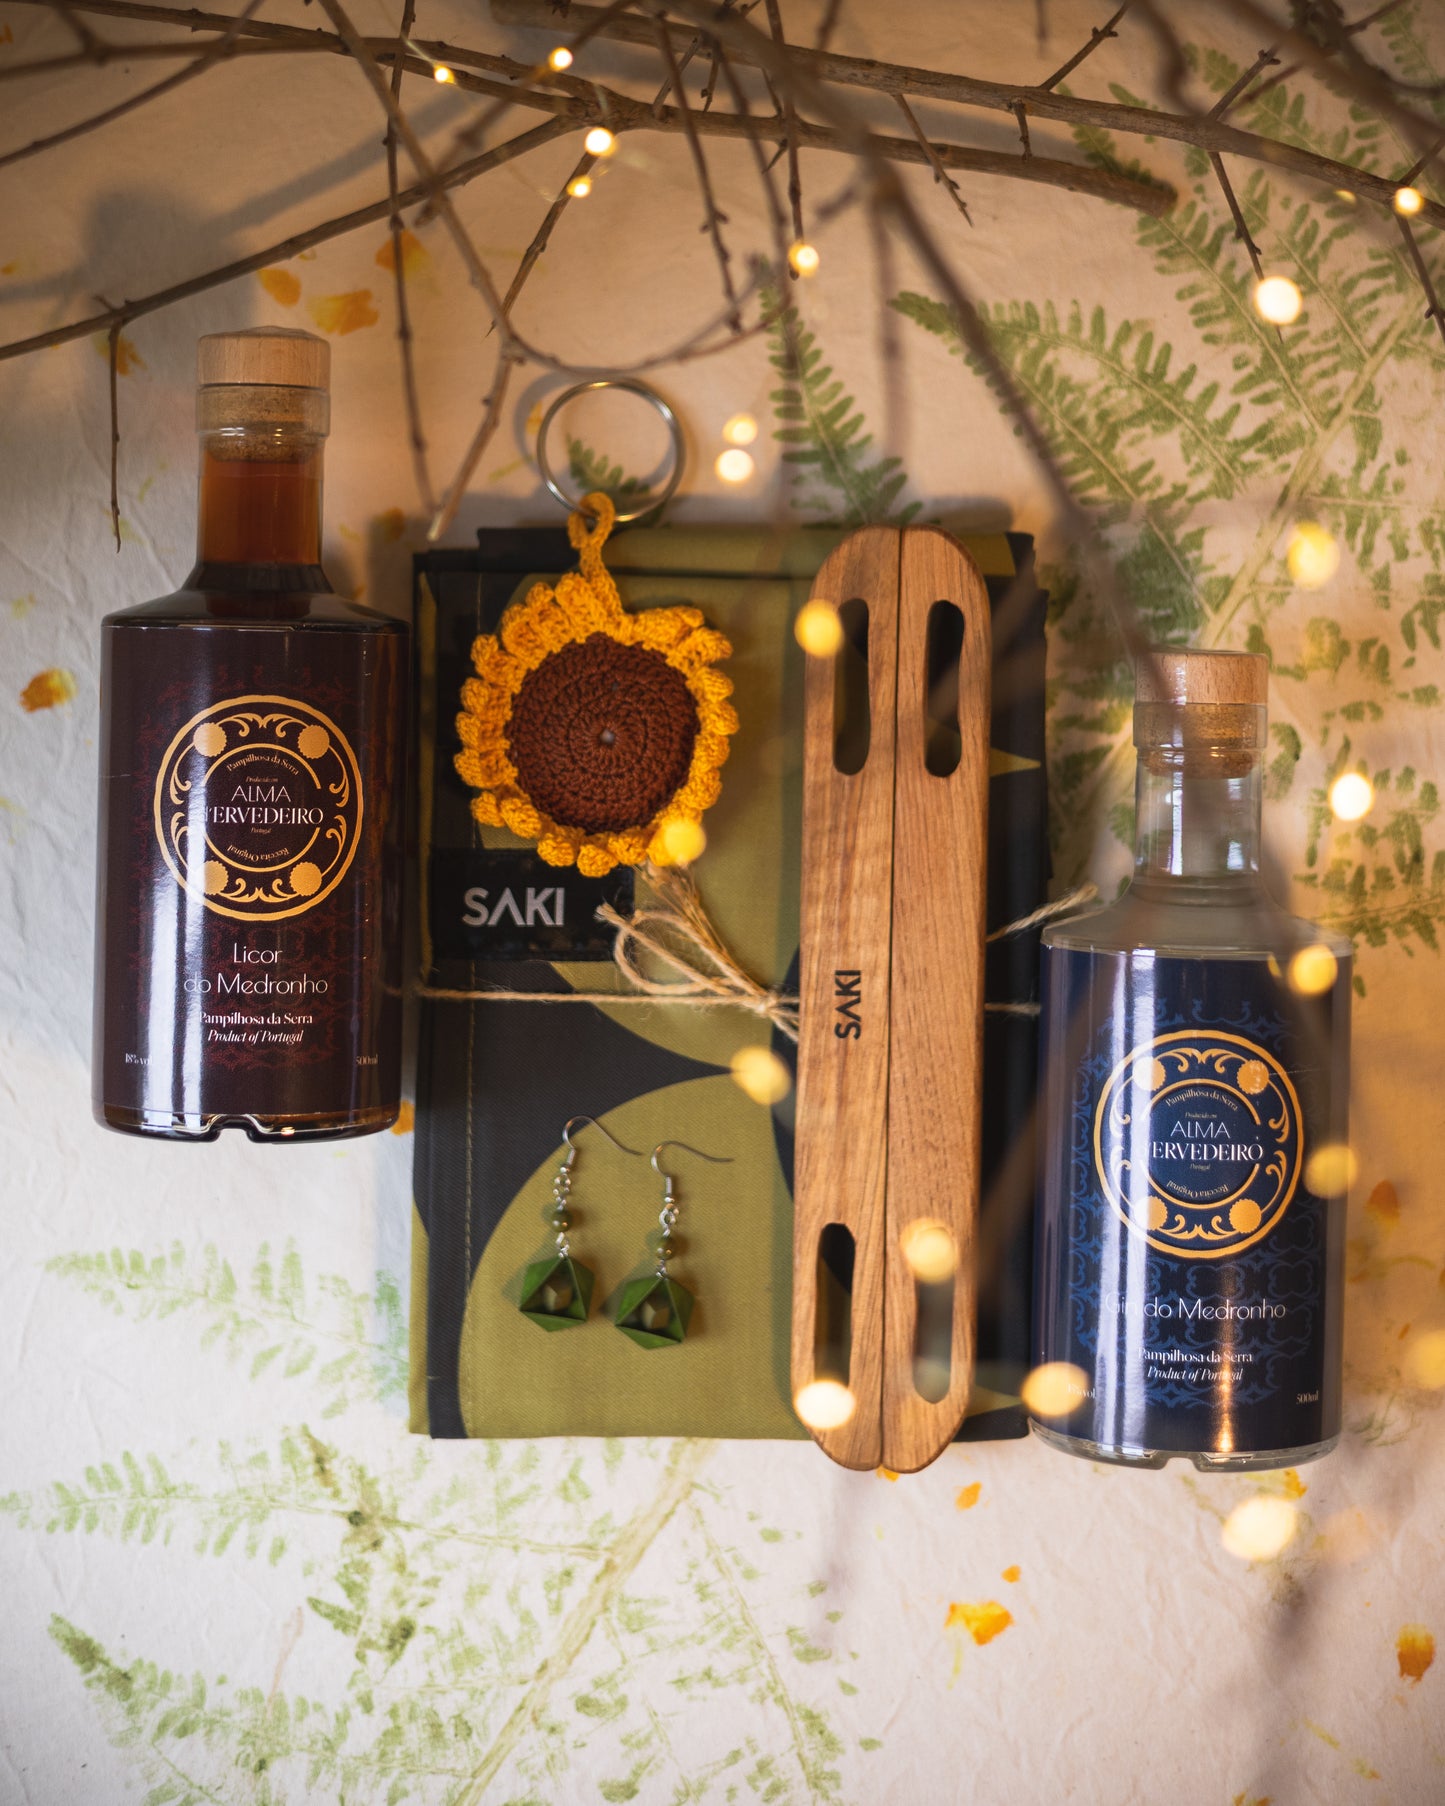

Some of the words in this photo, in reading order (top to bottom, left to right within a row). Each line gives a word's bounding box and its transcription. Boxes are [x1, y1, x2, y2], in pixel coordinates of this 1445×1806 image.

[226, 753, 270, 772] Pampilhosa
[271, 755, 281, 764] da
[281, 759, 299, 775] Serra
[231, 785, 292, 802] ALMA
[205, 806, 324, 825] 'ERVEDEIRO
[227, 844, 259, 862] Original
[259, 847, 290, 861] Receita
[462, 886, 565, 926] SAKI
[233, 942, 283, 964] Licor
[184, 972, 212, 993] do
[217, 972, 329, 995] Medronho
[834, 970, 861, 1040] SAKI
[200, 1012, 264, 1028] Pampilhosa
[266, 1012, 281, 1025] da
[284, 1013, 313, 1025] Serra
[207, 1030, 247, 1042] Product
[248, 1030, 262, 1045] of
[261, 1030, 304, 1045] Portugal
[1165, 1089, 1209, 1107] Pampilhosa
[1210, 1090, 1220, 1100] da
[1221, 1096, 1238, 1111] Serra
[1170, 1120, 1231, 1139] ALMA
[1166, 1180, 1198, 1198] Original
[1199, 1184, 1230, 1198] Receita
[1144, 1297, 1172, 1318] do
[1178, 1298, 1286, 1320] Medronho
[1138, 1347, 1204, 1364] Pampilhosa
[1206, 1350, 1221, 1363] da
[1223, 1350, 1253, 1363] Serra
[1148, 1365, 1186, 1380] Product
[1188, 1368, 1202, 1383] of
[1201, 1368, 1244, 1383] Portgal
[1295, 1389, 1319, 1405] 500ml
